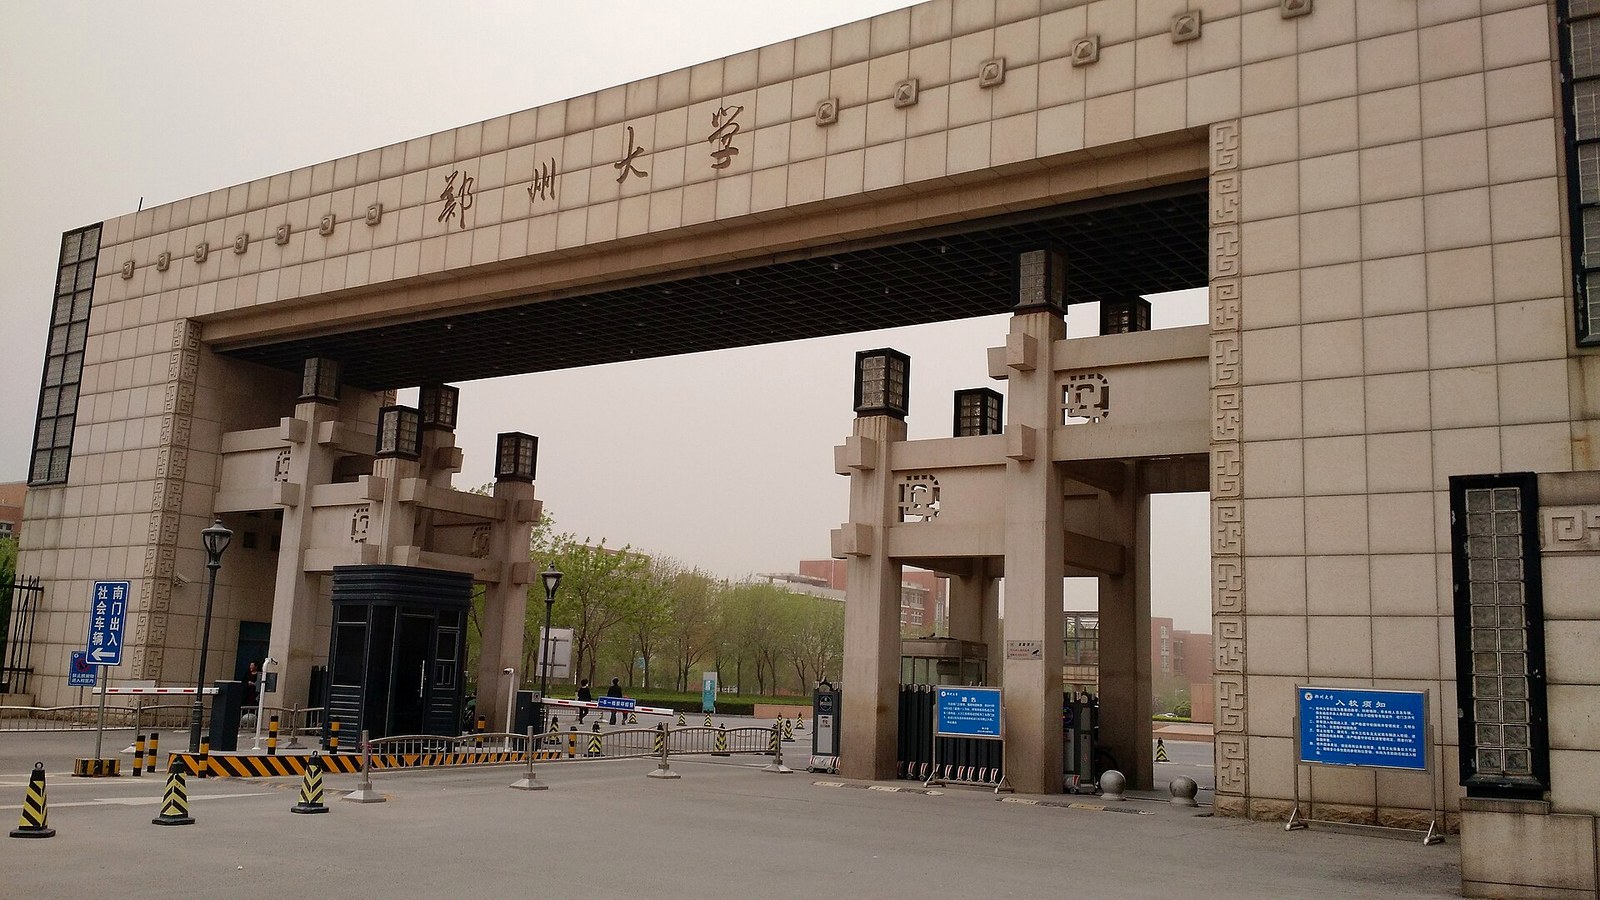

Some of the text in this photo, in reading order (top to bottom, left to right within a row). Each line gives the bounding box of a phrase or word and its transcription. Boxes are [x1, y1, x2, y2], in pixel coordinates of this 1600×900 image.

[438, 105, 743, 230] 郑州大学
[92, 586, 108, 646] 社会车辆
[107, 586, 124, 646] 南门出入
[1335, 699, 1386, 708] 入校须知
